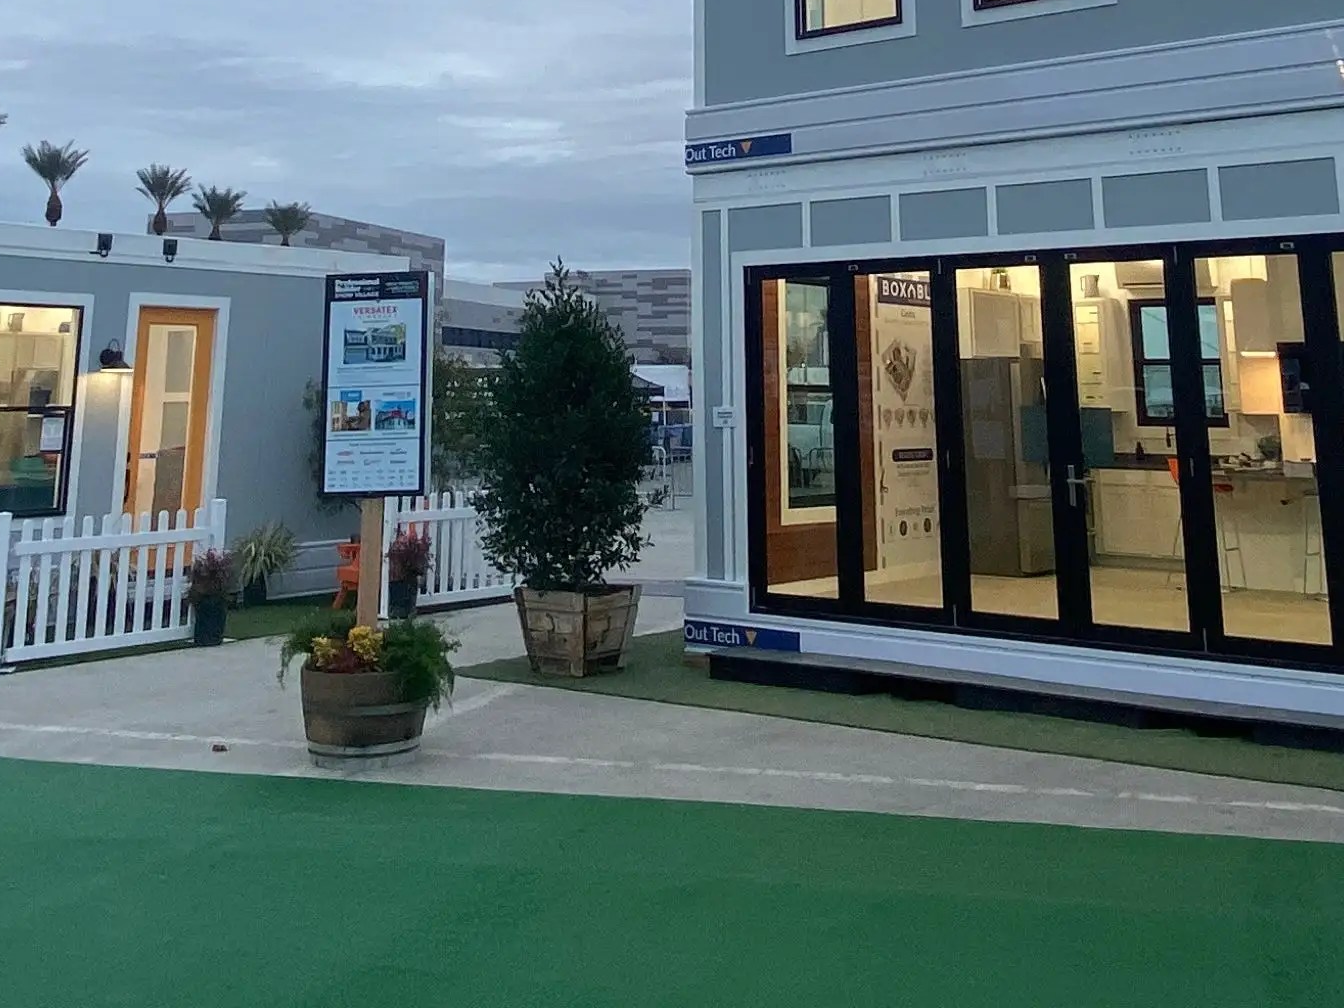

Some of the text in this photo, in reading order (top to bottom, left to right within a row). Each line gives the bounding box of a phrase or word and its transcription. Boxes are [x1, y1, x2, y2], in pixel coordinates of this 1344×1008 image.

[685, 143, 736, 162] Out Tech
[882, 279, 931, 301] BOXABL
[684, 623, 741, 645] Out Tech
